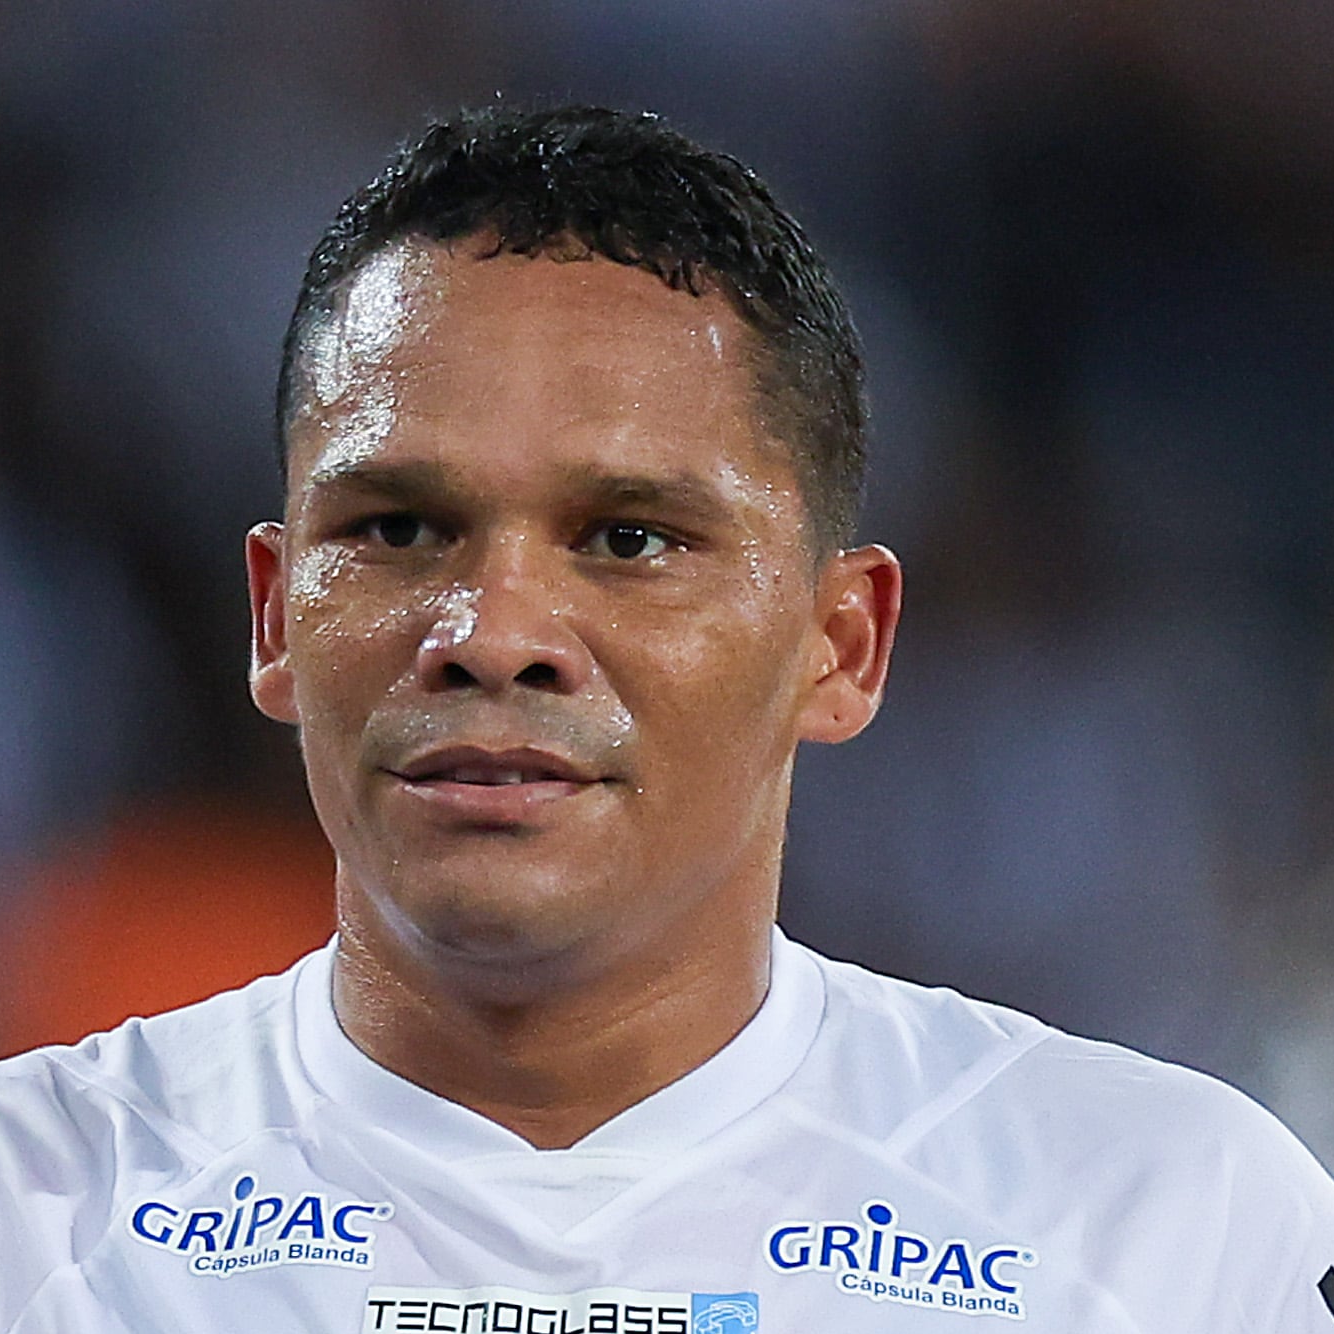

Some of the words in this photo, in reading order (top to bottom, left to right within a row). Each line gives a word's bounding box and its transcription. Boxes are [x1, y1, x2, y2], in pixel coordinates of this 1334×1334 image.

[194, 1246, 280, 1273] Cápsula
[288, 1244, 368, 1265] Blanda
[942, 1291, 1020, 1315] Blanda
